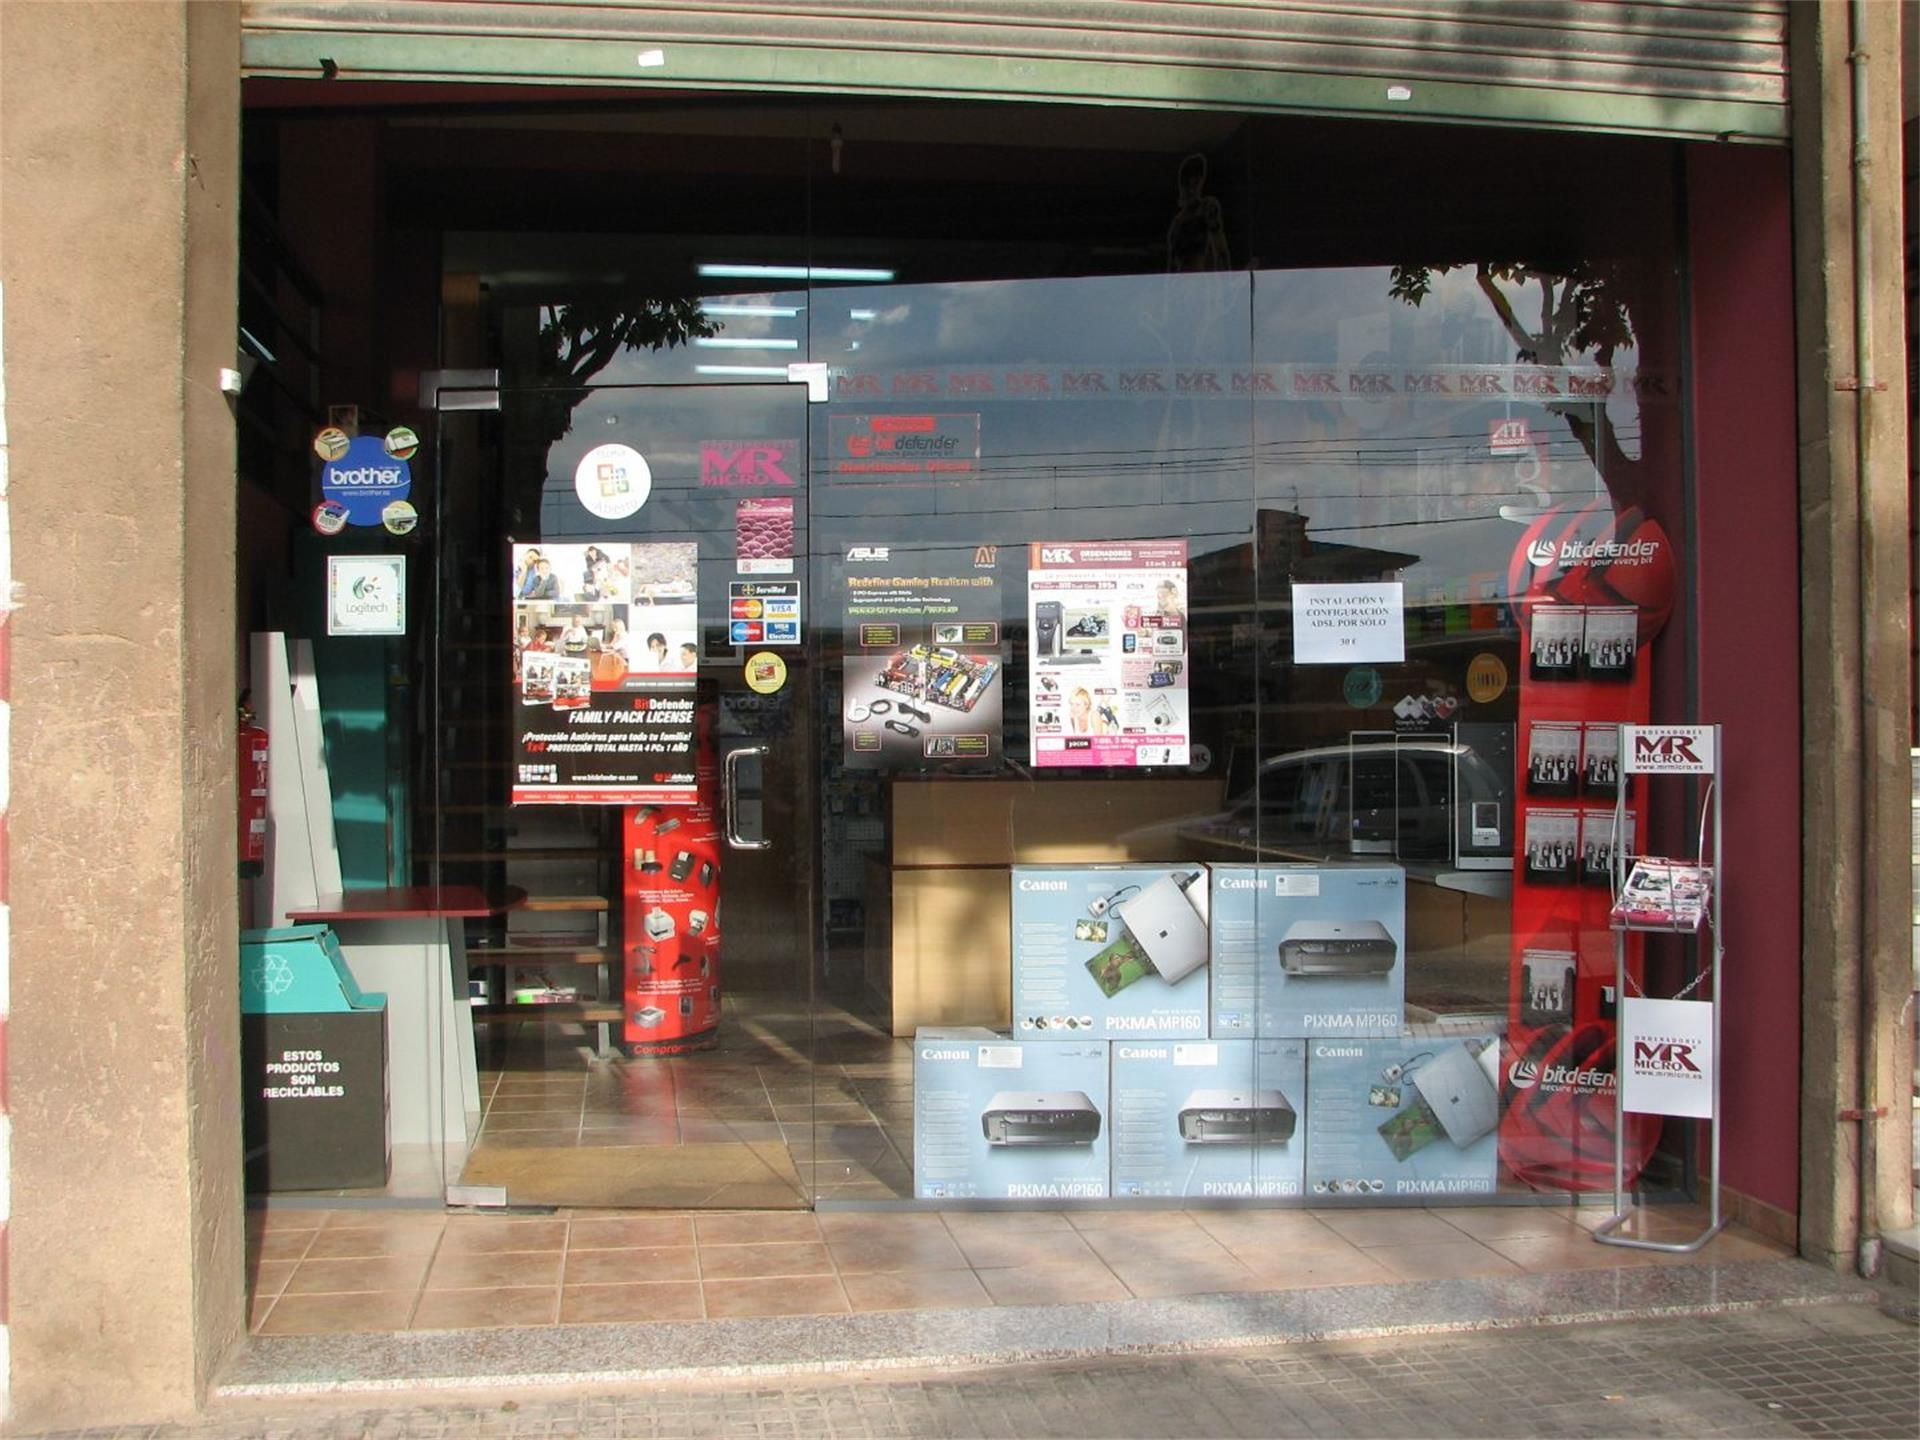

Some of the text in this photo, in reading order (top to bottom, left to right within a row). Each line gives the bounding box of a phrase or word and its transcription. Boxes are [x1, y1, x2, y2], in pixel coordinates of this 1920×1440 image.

[1492, 422, 1525, 438] ATI
[703, 447, 796, 486] MR
[330, 467, 402, 485] brother
[847, 547, 889, 558] ASUS
[1560, 539, 1659, 559] bitdefender
[1591, 559, 1613, 568] your
[1614, 558, 1639, 567] every
[1640, 557, 1653, 565] bit
[848, 576, 993, 588] Redefine Gaming Realism with
[1310, 595, 1384, 606] INSTALACIÓN Y
[346, 603, 388, 616] Logitech
[1306, 607, 1389, 617] CONFIGURACIÓN
[1311, 619, 1336, 628] ADSL
[1337, 619, 1358, 627] POR
[1339, 638, 1351, 646] 30
[634, 698, 694, 710] BitDefender
[569, 711, 694, 723] FAMILY PACK LICENSE
[570, 732, 607, 741] Antivirus
[608, 734, 627, 743] para
[629, 732, 648, 742] toda
[649, 732, 659, 742] tu
[660, 732, 692, 742] familia!
[594, 743, 617, 752] TOTAL
[618, 743, 643, 752] HASTA
[644, 743, 651, 752] 4
[671, 742, 689, 752] AÑO
[1635, 736, 1702, 763] MR
[1635, 754, 1684, 764] MICRO
[1019, 880, 1068, 892] Canon
[1220, 878, 1268, 889] Canon
[1105, 1017, 1155, 1030] PIXMA
[1303, 1014, 1354, 1027] PIXMA
[1634, 1036, 1702, 1044] ORDENADORES
[283, 1051, 322, 1062] ESTOS
[921, 1048, 970, 1060] Canon
[1119, 1047, 1168, 1059] Canon
[1316, 1046, 1364, 1057] Canon
[1634, 1042, 1701, 1072] MR
[266, 1063, 340, 1073] PRODUCTOS
[1634, 1060, 1683, 1071] MICRO
[291, 1075, 316, 1085] SON
[1634, 1070, 1703, 1080] www.mrmicro.es
[263, 1087, 344, 1098] RECICLABLES
[1541, 1084, 1572, 1092] secure
[1573, 1085, 1596, 1095] your
[1008, 1184, 1059, 1198] PIXMA
[1203, 1182, 1253, 1195] PIXMA
[1397, 1180, 1446, 1193] PIXMA
